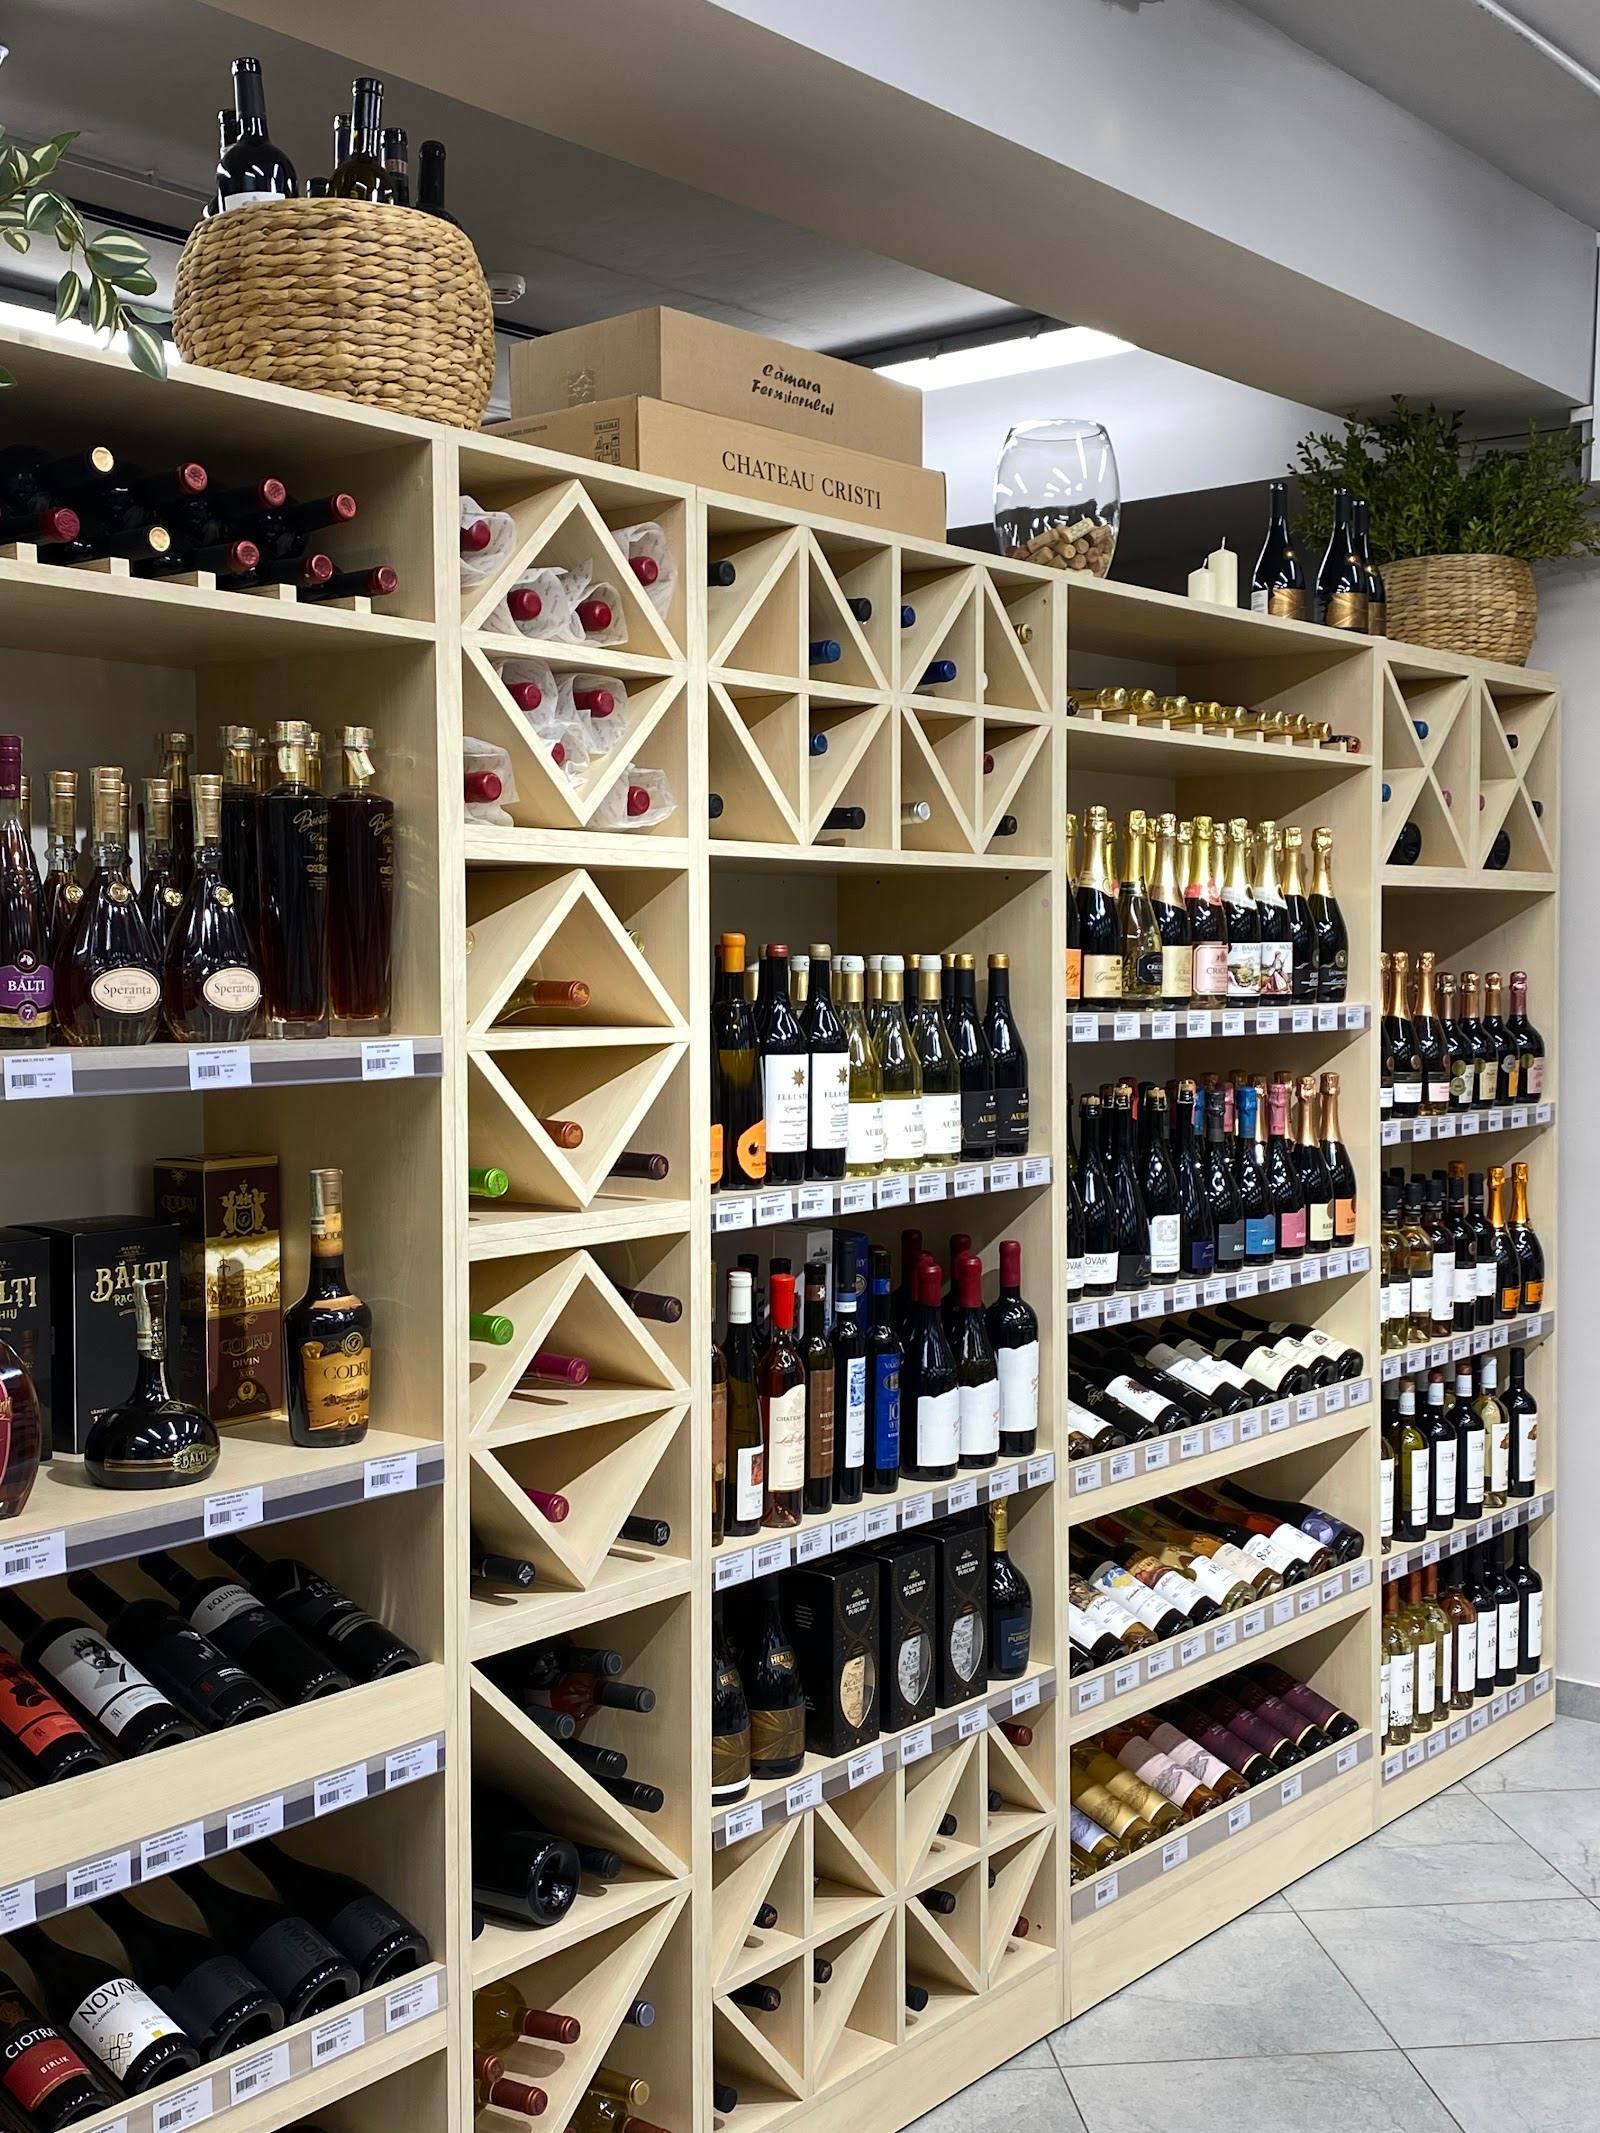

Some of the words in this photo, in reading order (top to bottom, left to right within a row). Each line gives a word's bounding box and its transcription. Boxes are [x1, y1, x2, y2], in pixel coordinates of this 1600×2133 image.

[722, 449, 815, 492] CHATEAU
[821, 476, 881, 510] CRISTI
[24, 1008, 32, 1019] 7
[232, 1356, 260, 1368] DIVIN
[79, 1980, 140, 2024] NOVAK
[40, 2055, 70, 2074] BIRLIK
